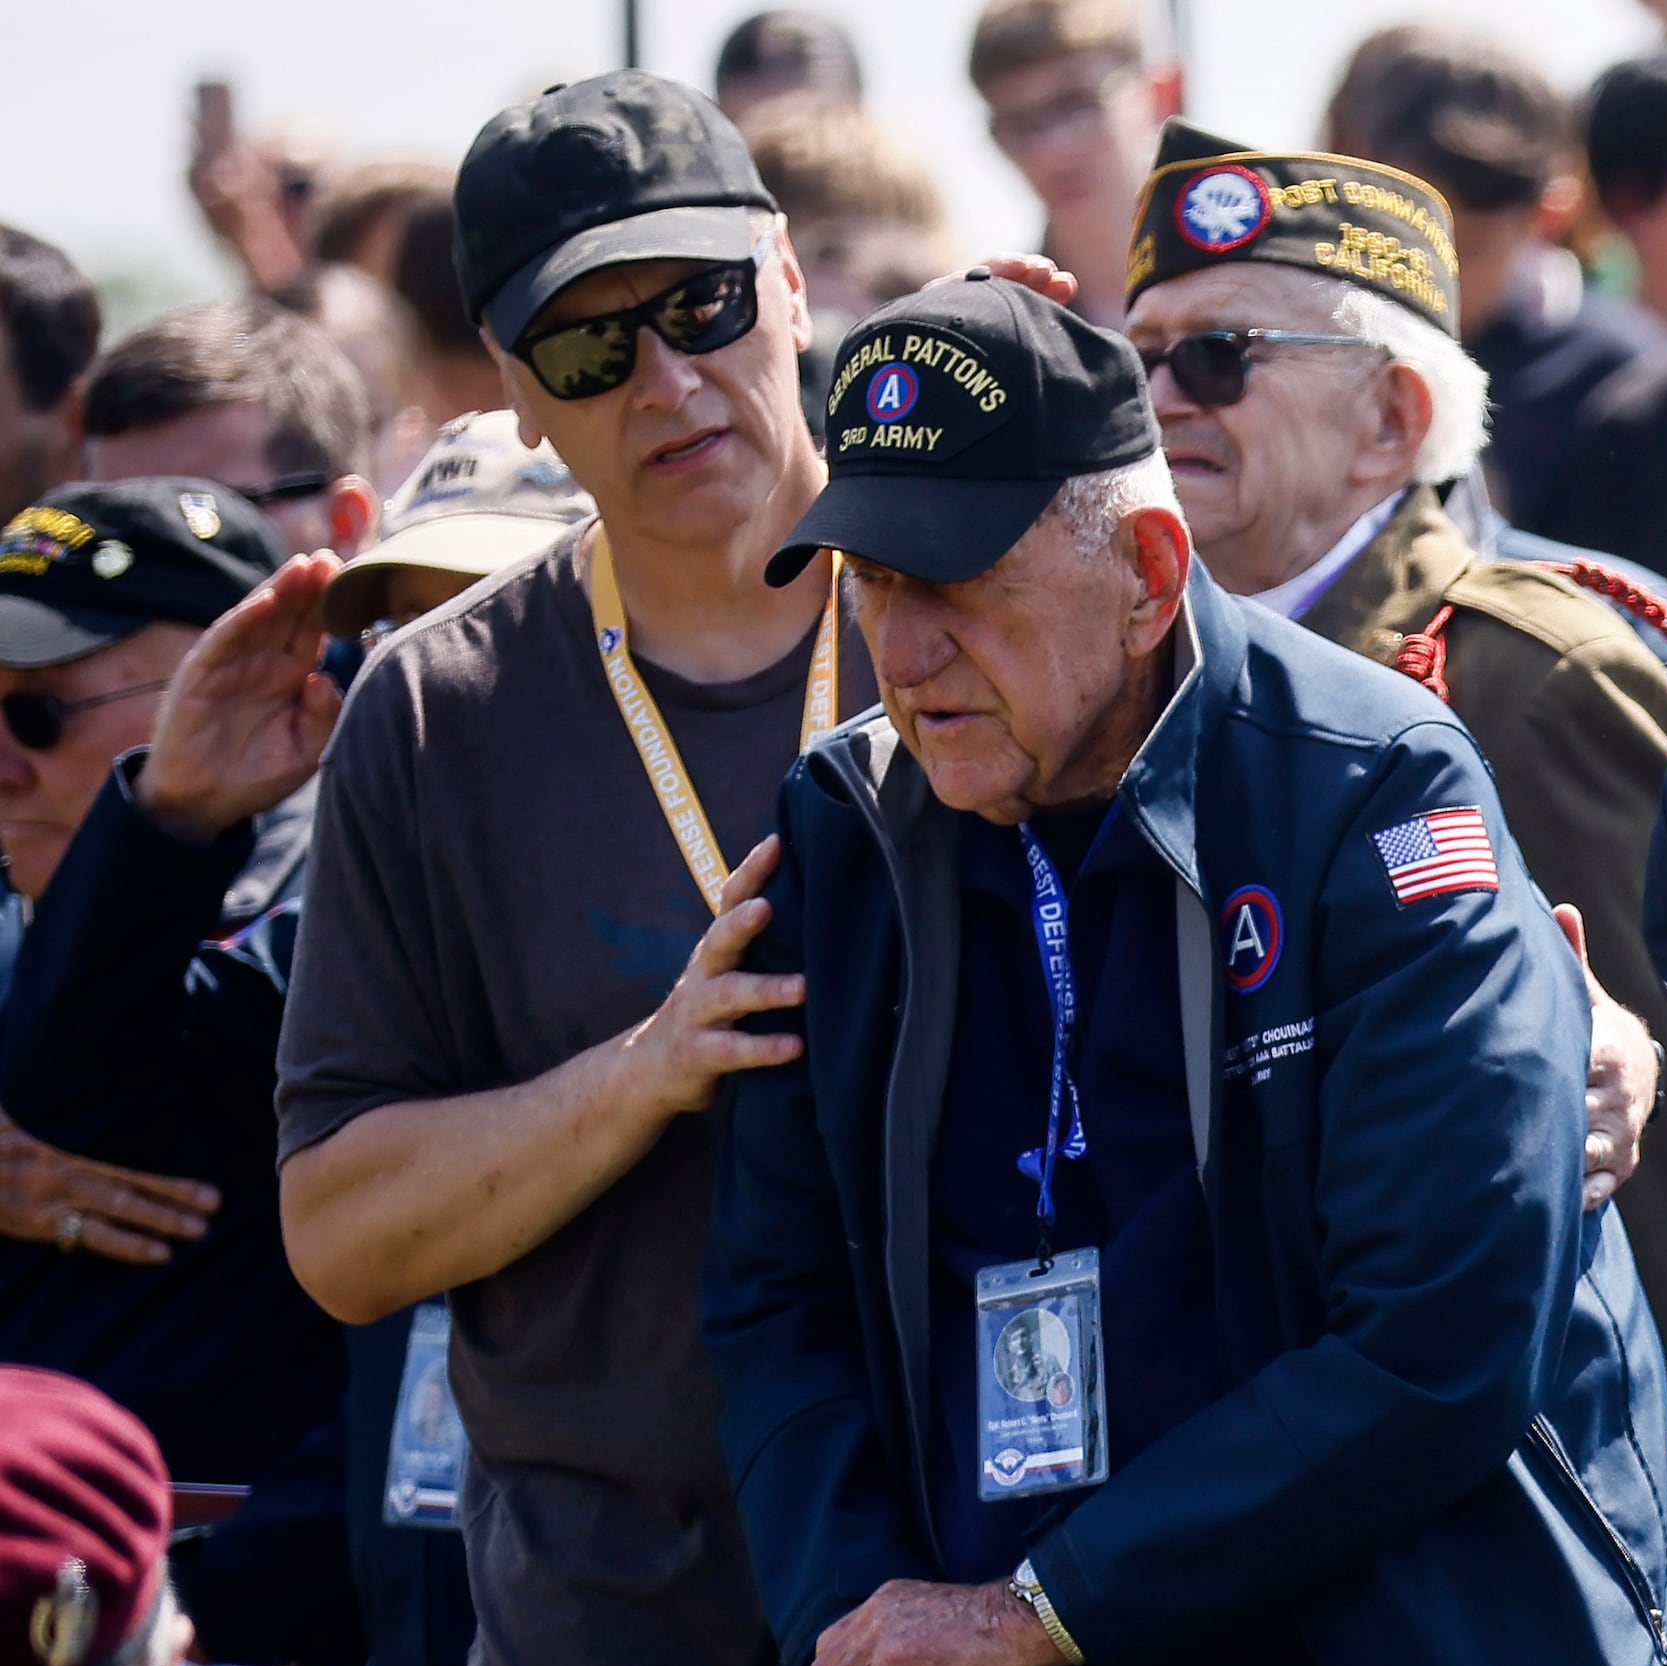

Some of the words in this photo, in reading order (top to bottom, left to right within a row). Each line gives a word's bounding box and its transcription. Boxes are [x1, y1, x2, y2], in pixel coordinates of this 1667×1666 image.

[1268, 178, 1338, 209] POST
[828, 335, 895, 416] GENERAL
[902, 335, 1007, 413] PATTON'S
[877, 374, 900, 409] A
[839, 426, 868, 452] 3RD
[870, 424, 944, 451] ARMY
[607, 655, 688, 809] FOUNDATION
[673, 807, 726, 904] EFENSE
[1026, 844, 1056, 898] BEST
[1228, 904, 1265, 966] A
